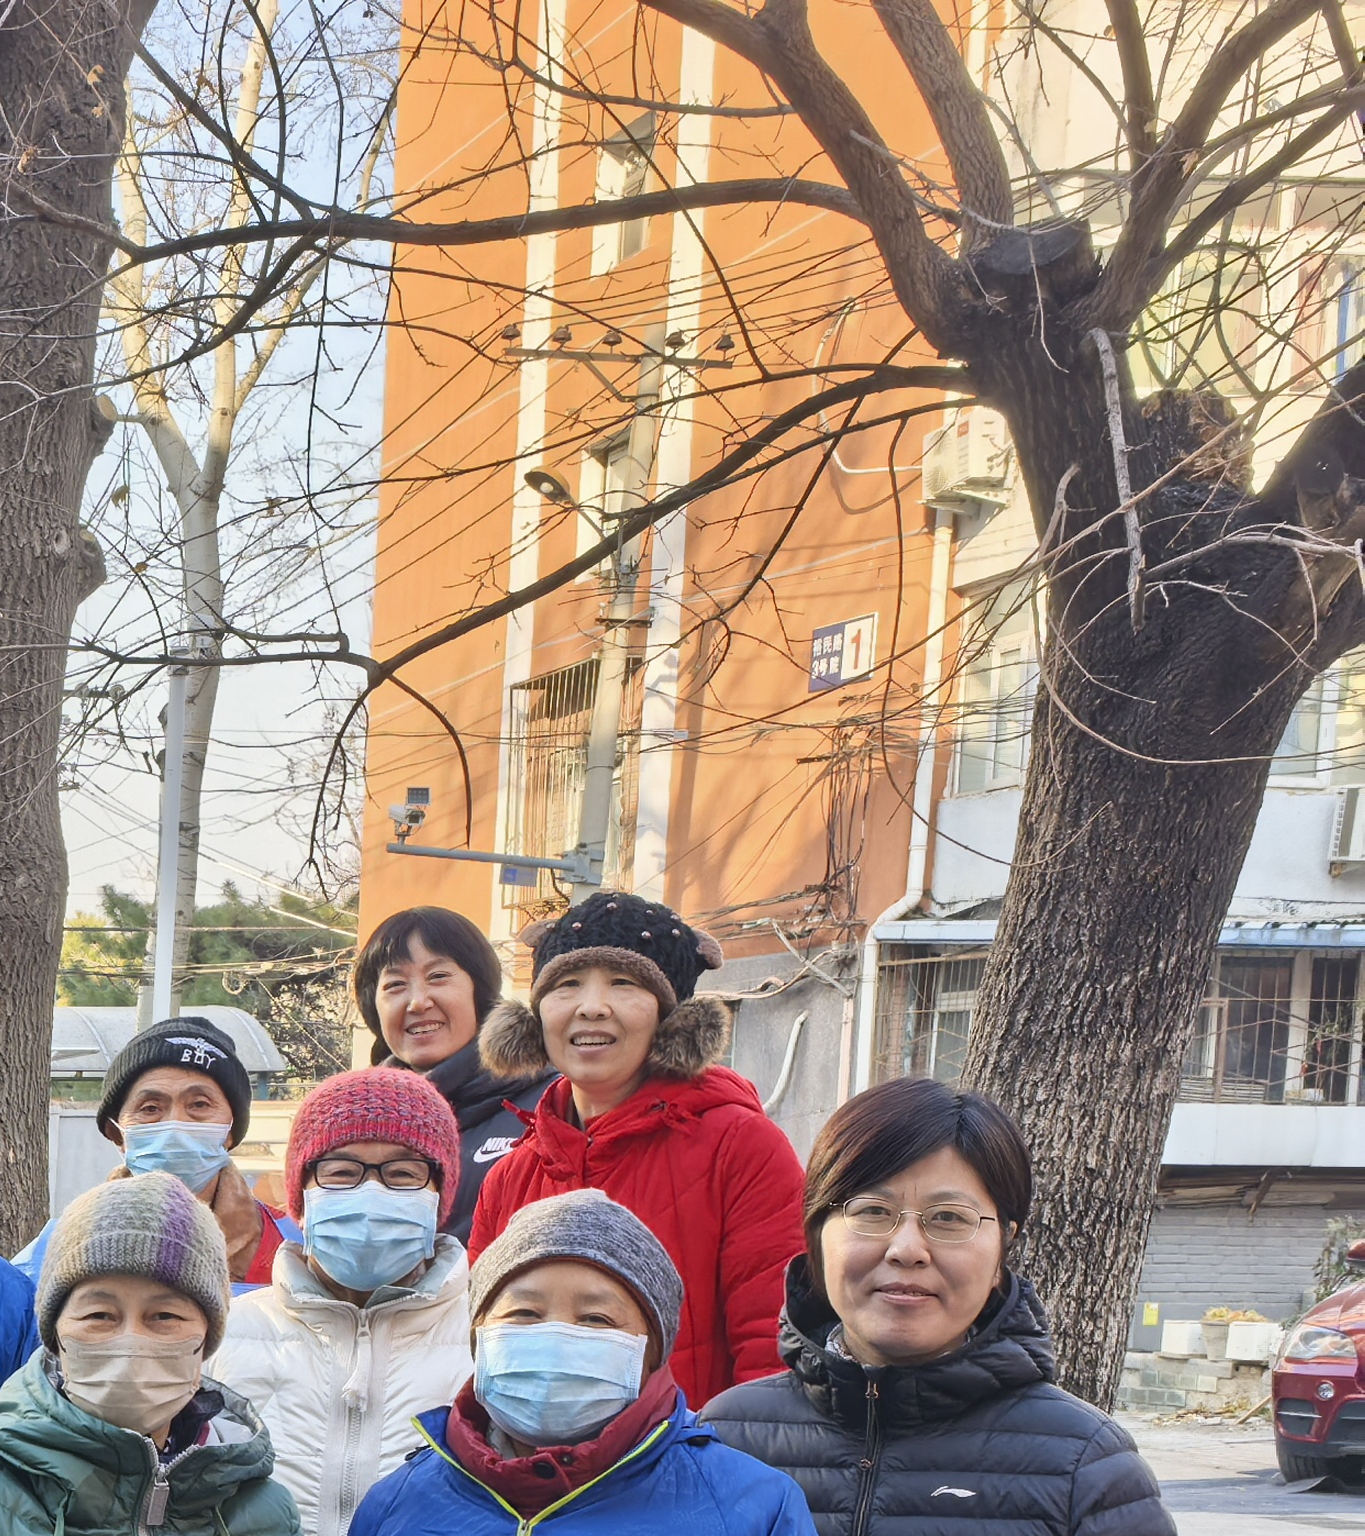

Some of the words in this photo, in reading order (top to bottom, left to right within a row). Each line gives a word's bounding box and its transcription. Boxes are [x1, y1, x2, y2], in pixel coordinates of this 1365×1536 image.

[851, 628, 862, 670] 1
[180, 1048, 217, 1069] BOY
[480, 1136, 519, 1152] NIKE
